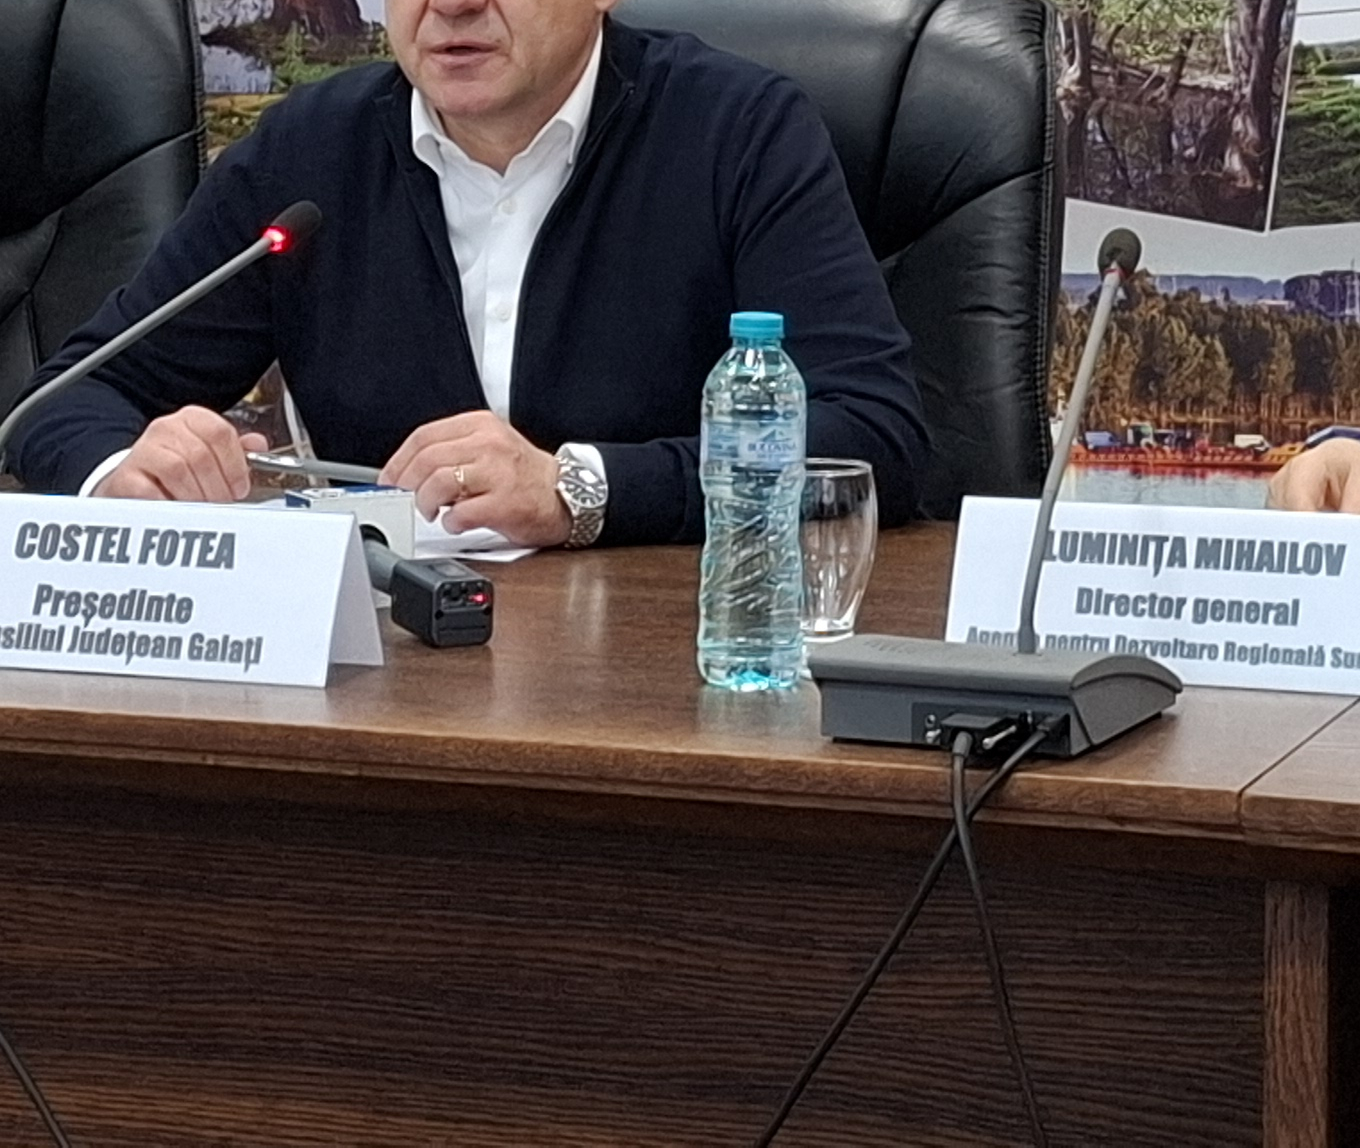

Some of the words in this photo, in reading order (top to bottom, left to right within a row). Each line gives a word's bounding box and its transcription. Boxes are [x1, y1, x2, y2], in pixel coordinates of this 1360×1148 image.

[13, 521, 132, 565] COSTEL
[137, 528, 237, 570] FOTEA
[1194, 536, 1347, 577] MIHAILOV
[32, 583, 194, 628] Președinte
[1075, 586, 1187, 621] Director
[1191, 596, 1301, 626] general
[66, 625, 183, 666] Județean
[187, 632, 264, 673] Galați
[1114, 633, 1219, 663] Dezvoltare
[1223, 641, 1326, 668] Regională
